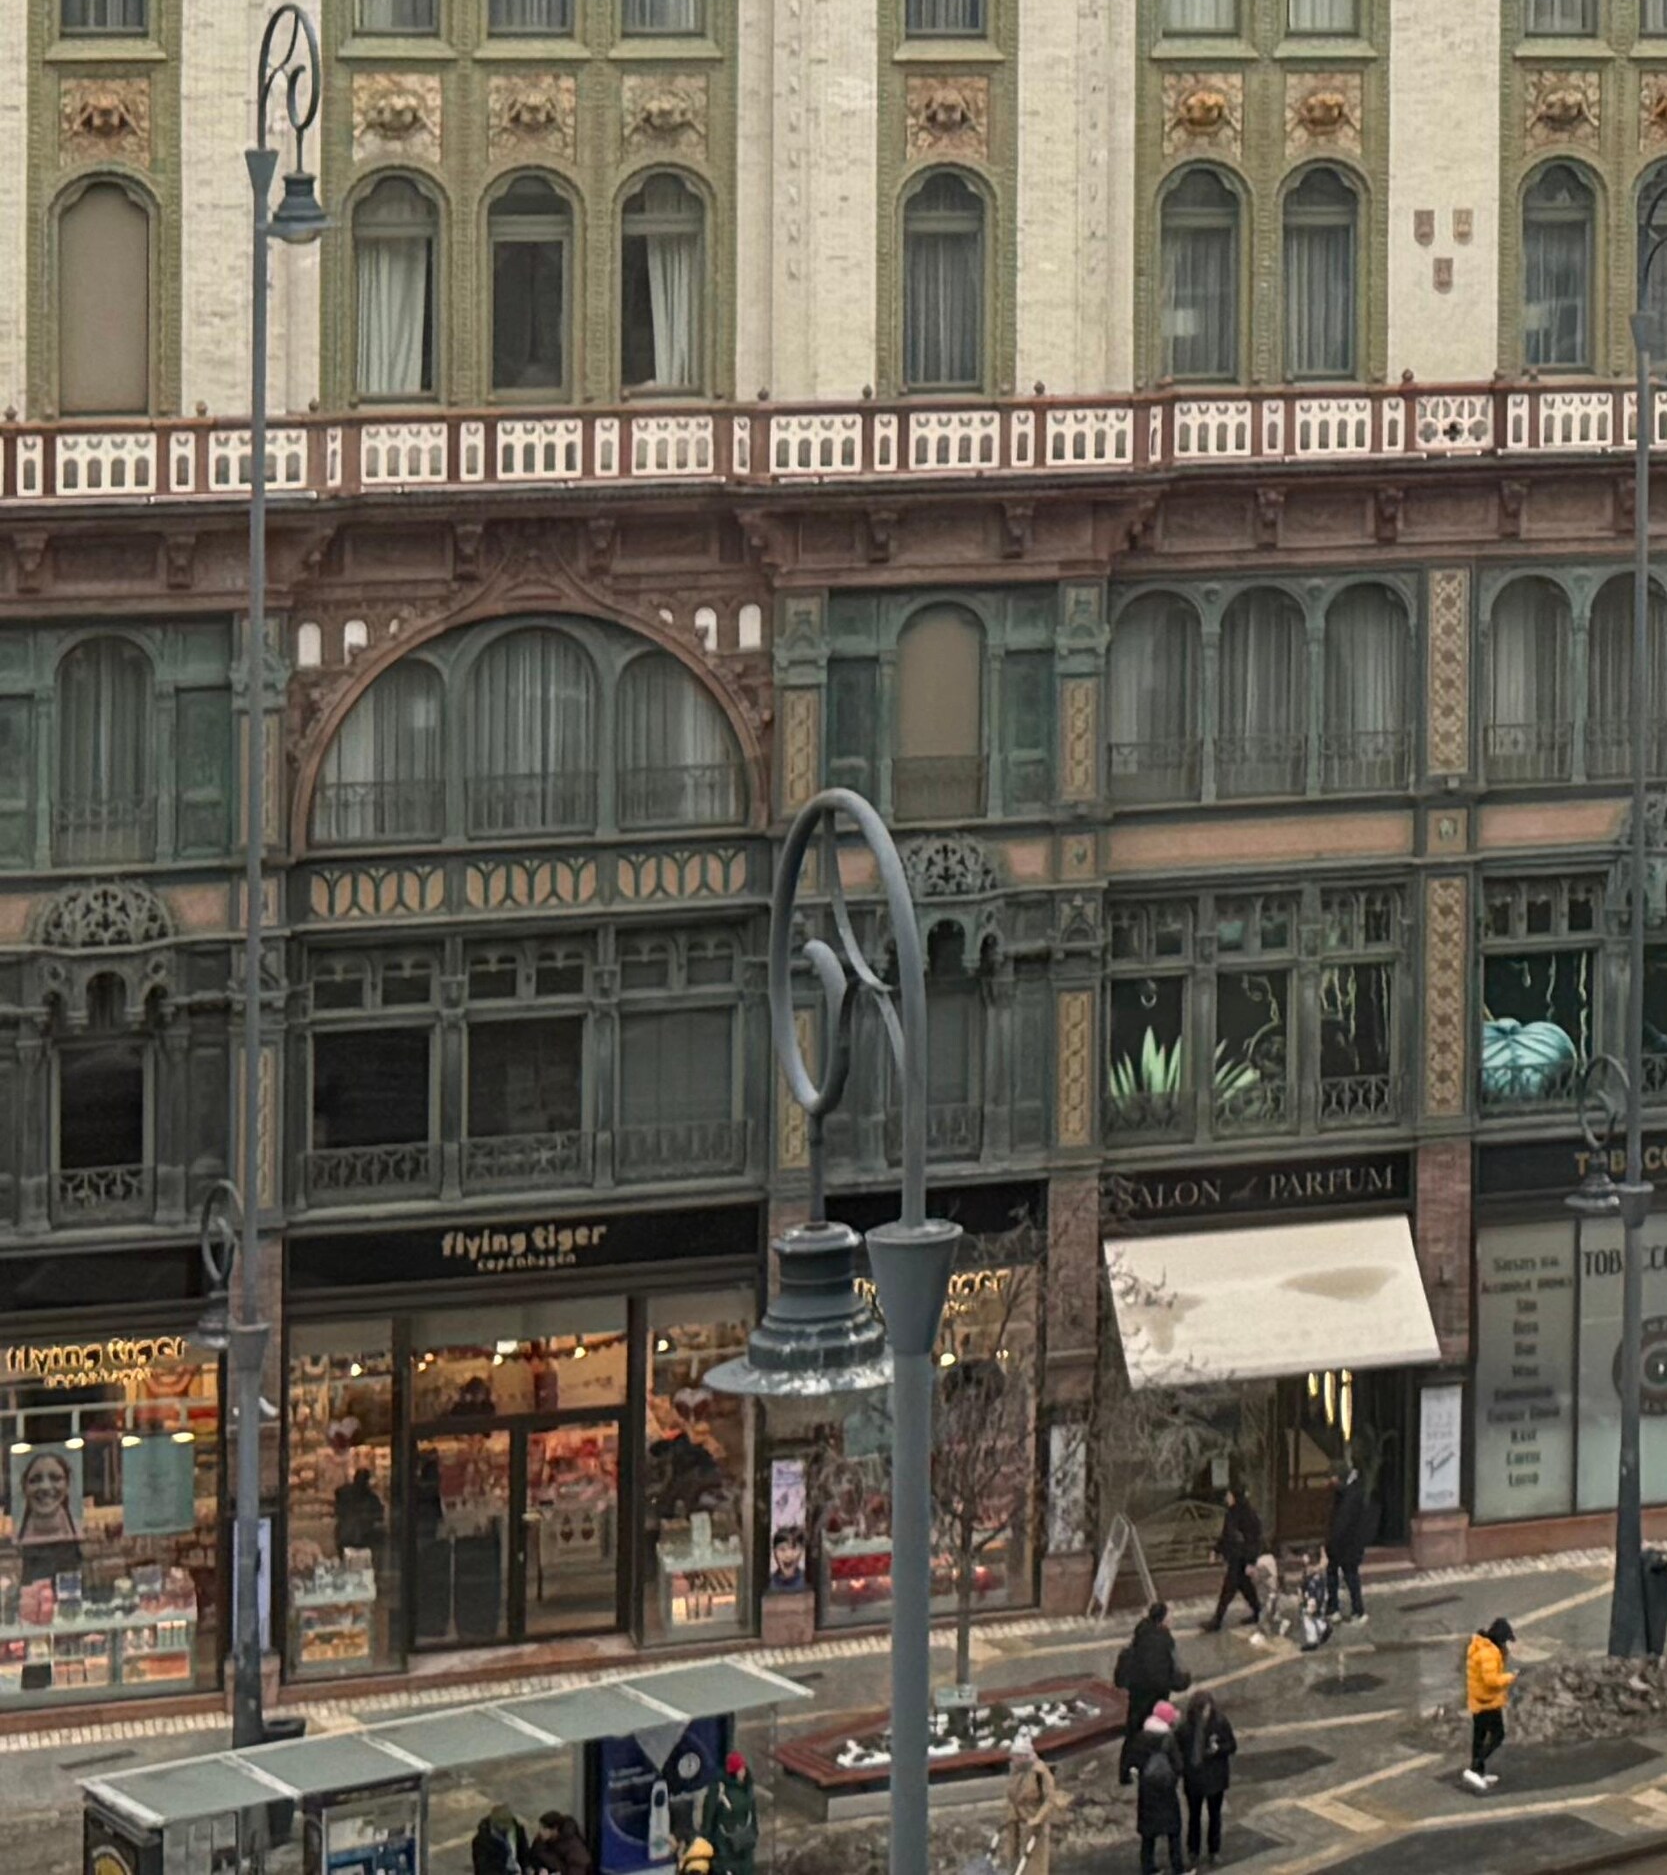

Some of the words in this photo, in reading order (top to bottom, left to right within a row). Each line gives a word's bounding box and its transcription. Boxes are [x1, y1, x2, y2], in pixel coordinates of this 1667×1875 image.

[1118, 1179, 1221, 1209] SALON
[1269, 1165, 1393, 1200] PARFUM
[442, 1228, 527, 1261] flying
[532, 1224, 607, 1252] tiger
